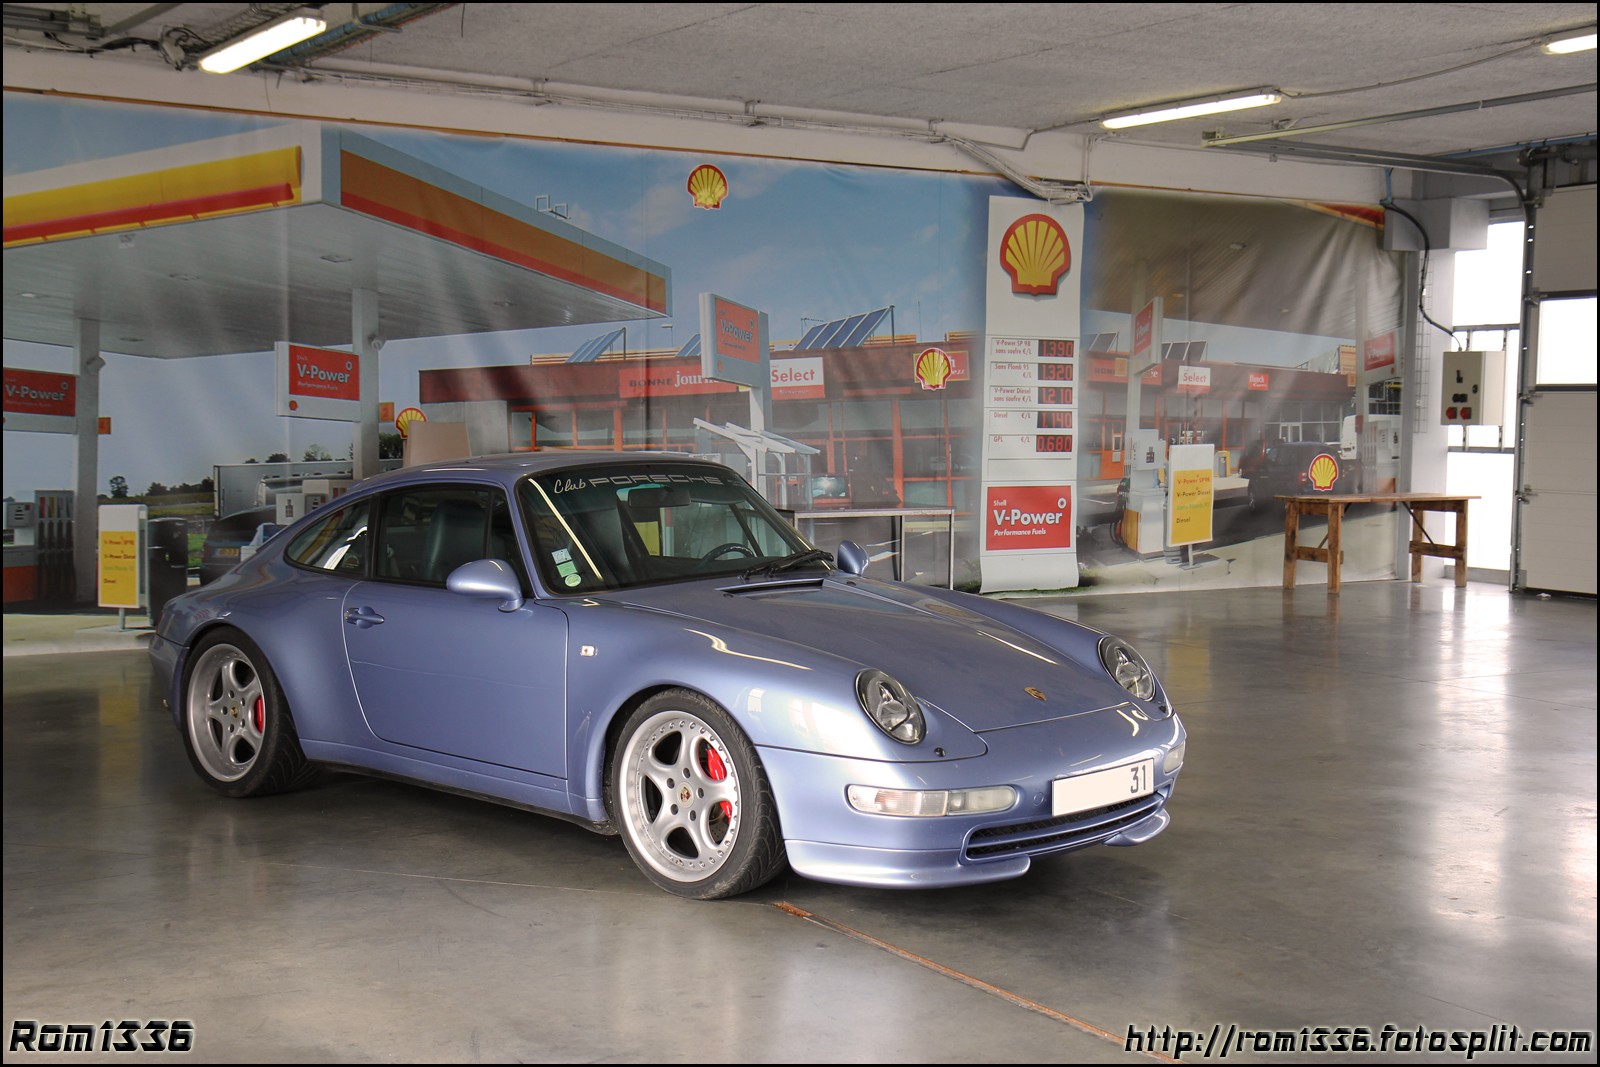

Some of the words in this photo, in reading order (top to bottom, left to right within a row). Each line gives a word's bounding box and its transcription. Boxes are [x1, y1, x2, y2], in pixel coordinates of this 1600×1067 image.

[296, 363, 350, 383] V-Power
[771, 368, 815, 384] Select
[1183, 371, 1207, 383] Select
[629, 378, 673, 387] BONNE
[5, 384, 66, 401] V-Power
[1016, 387, 1031, 395] Diesel
[1037, 436, 1072, 452] 0.680
[553, 478, 586, 494] Club
[588, 474, 724, 488] PORSCHE
[993, 499, 1007, 507] Shell
[993, 509, 1063, 526] V-Power
[1130, 765, 1146, 794] 31
